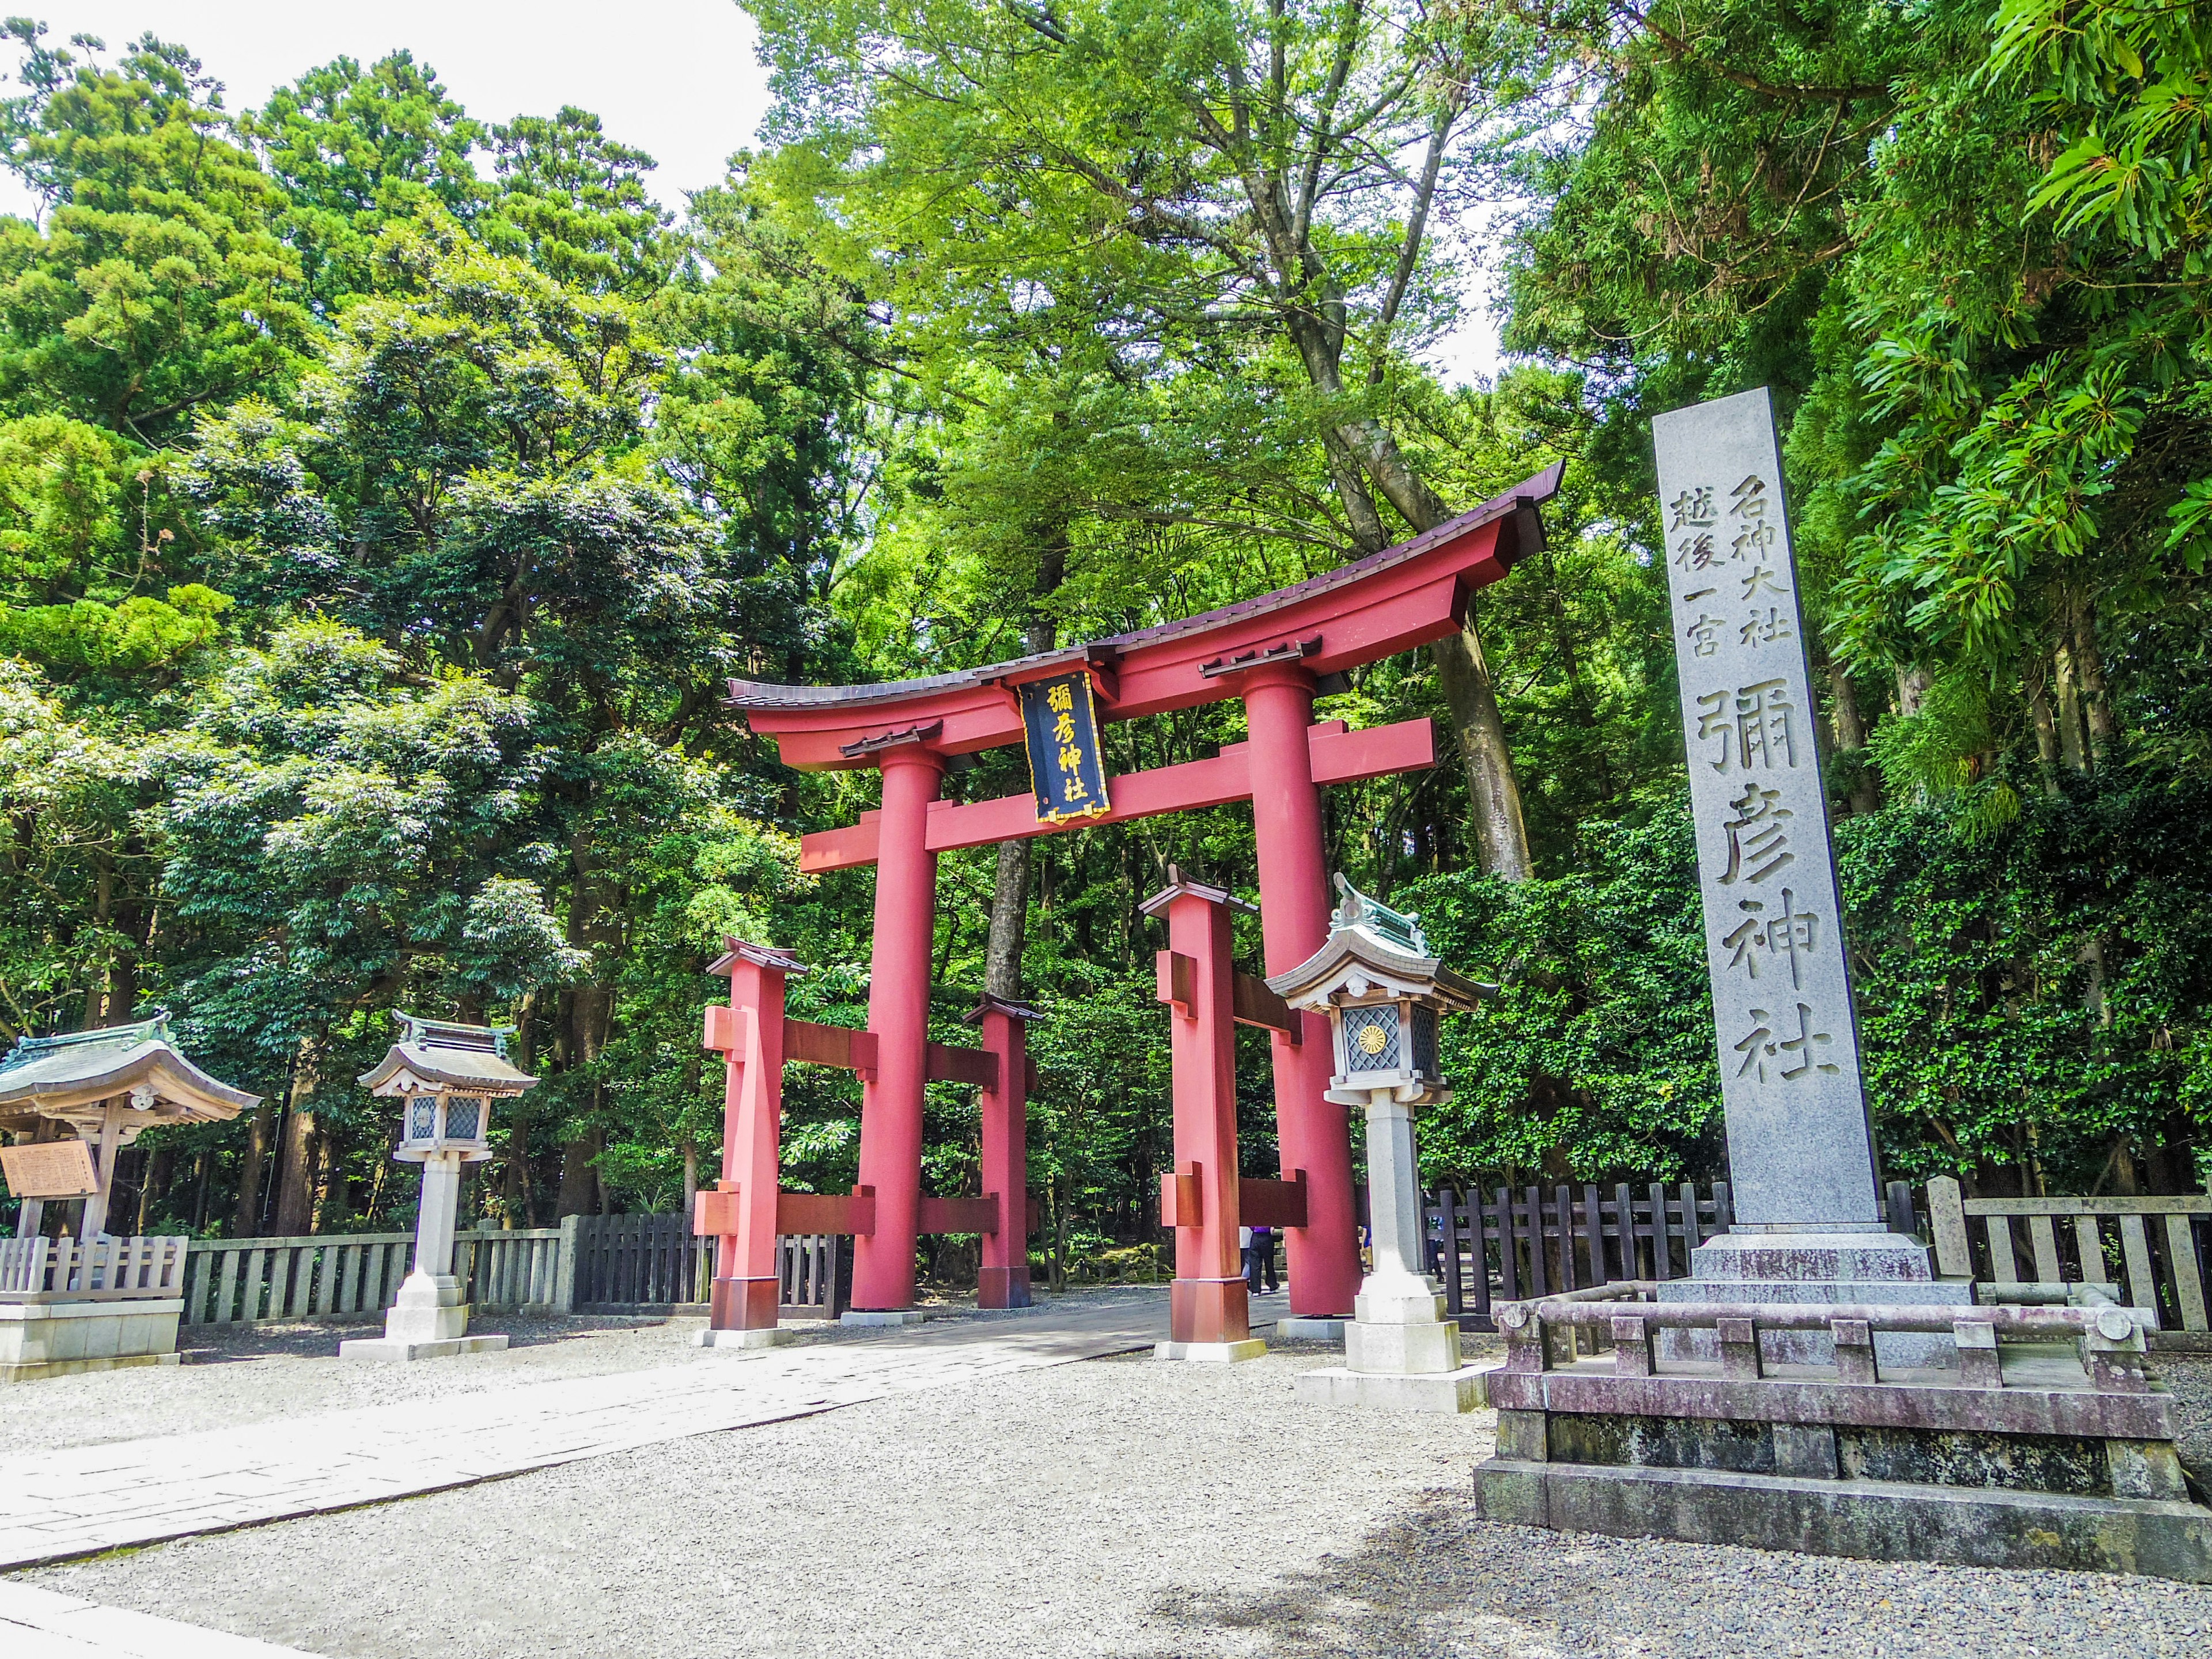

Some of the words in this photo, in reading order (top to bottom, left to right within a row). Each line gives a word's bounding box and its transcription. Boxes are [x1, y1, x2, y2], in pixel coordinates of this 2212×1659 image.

[1670, 486, 1726, 657] 越後一宮
[1730, 474, 1792, 648] 名神大社
[1047, 683, 1088, 802] 彌彦神社
[1697, 678, 1840, 1085] 彌彦神社
